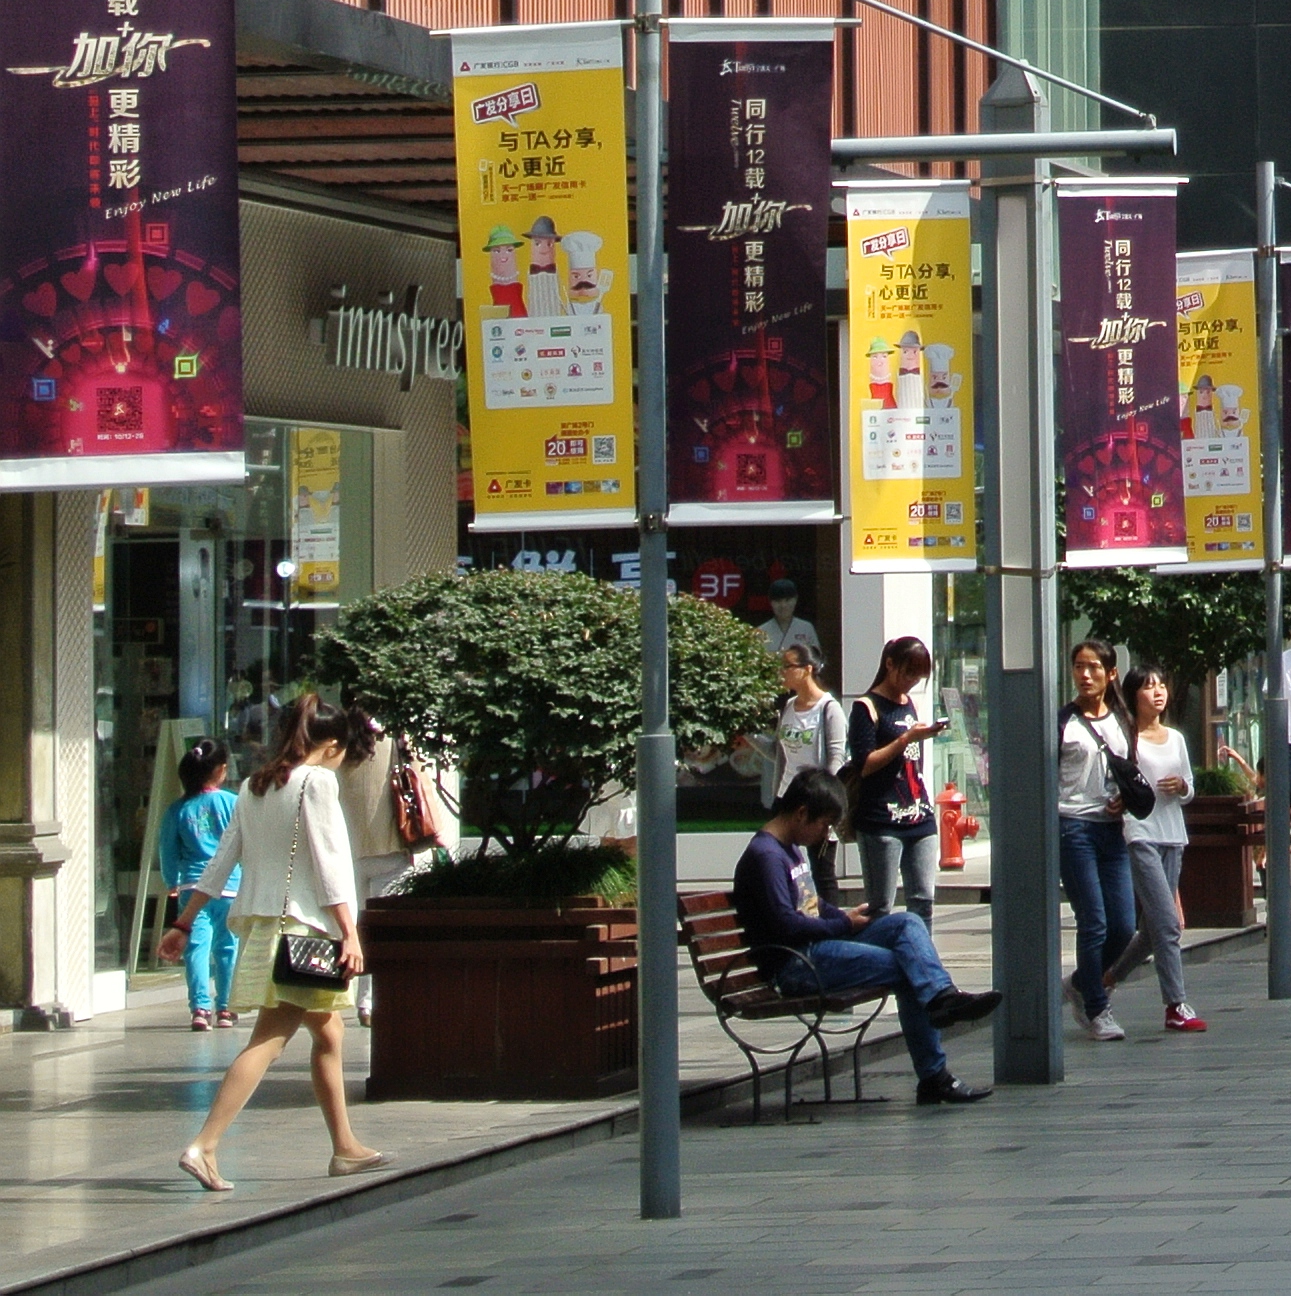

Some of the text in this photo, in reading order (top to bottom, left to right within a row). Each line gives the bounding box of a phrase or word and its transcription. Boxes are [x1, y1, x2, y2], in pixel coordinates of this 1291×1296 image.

[475, 87, 534, 119] 广发分享日
[108, 88, 141, 189] 更精彩
[745, 99, 766, 190] 同行12载
[498, 155, 566, 179] 心更近
[104, 174, 218, 220] Enjoy New Life
[744, 241, 766, 314] 更精彩
[879, 284, 929, 301] 心更近
[336, 285, 463, 388] innisfree
[1117, 348, 1135, 405] 更精彩
[547, 440, 566, 457] 20
[700, 574, 741, 597] 3F
